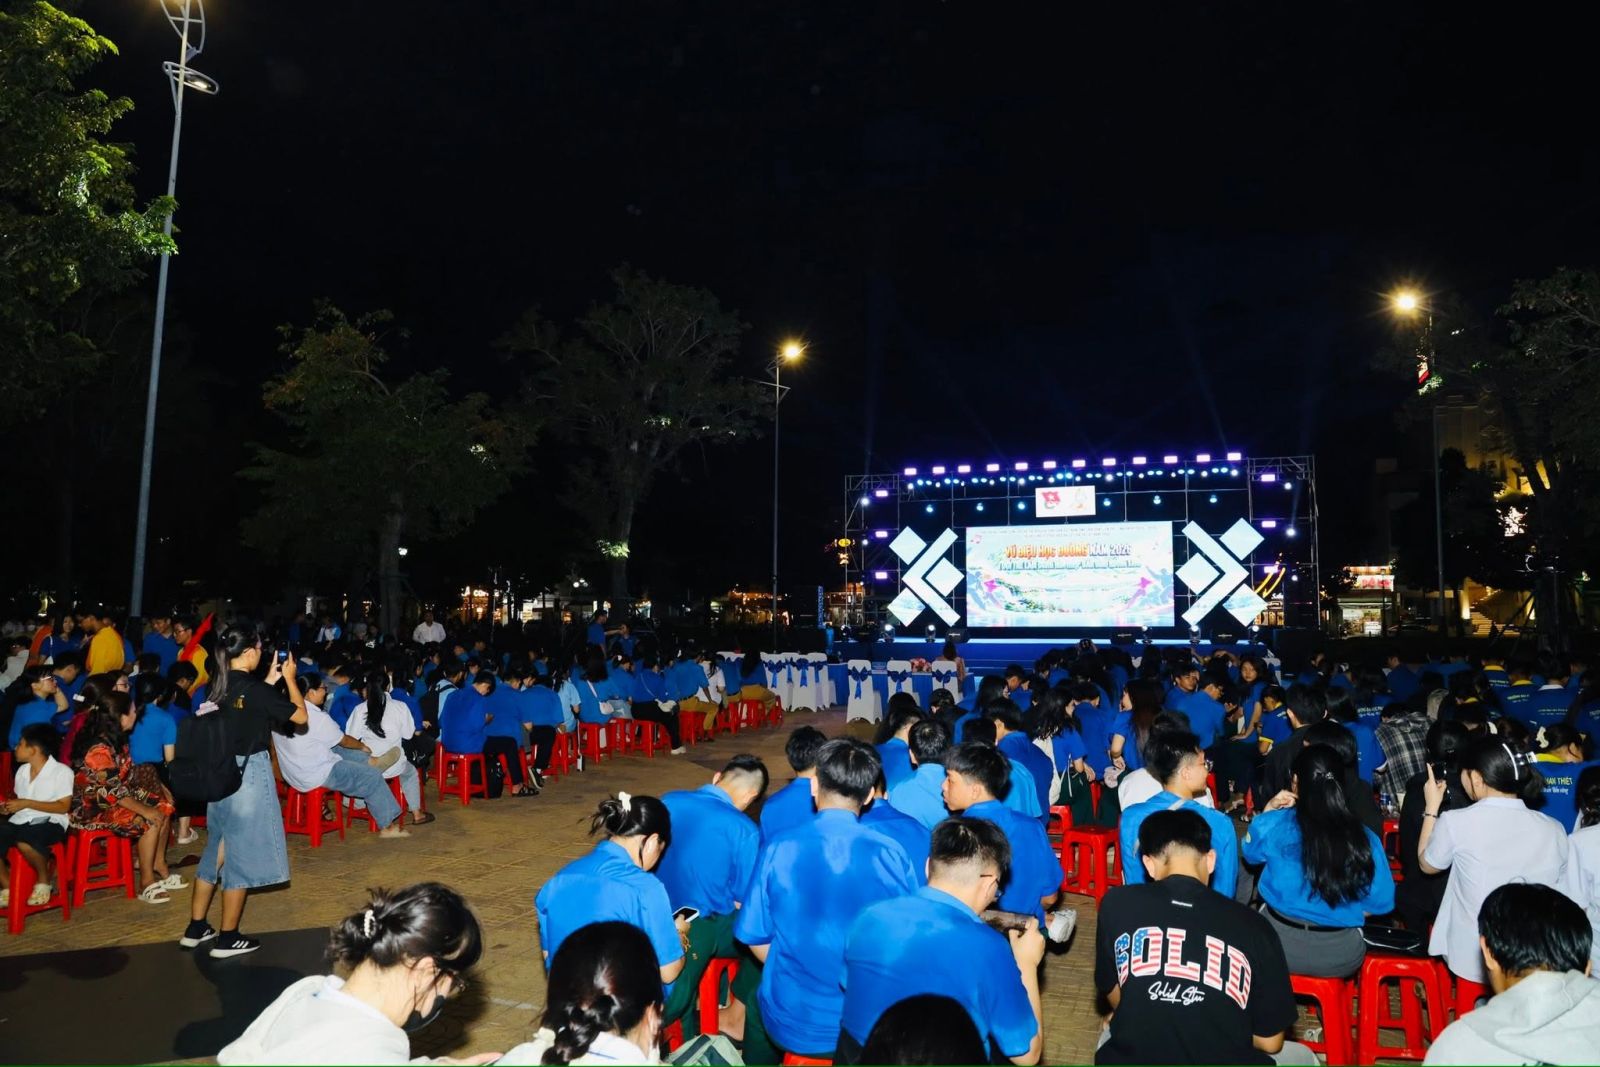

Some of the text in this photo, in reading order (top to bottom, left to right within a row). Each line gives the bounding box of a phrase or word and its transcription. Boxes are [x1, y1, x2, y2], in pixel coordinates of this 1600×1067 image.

[1018, 544, 1037, 559] ĐIỆU
[1038, 544, 1057, 560] HỌC
[1058, 541, 1089, 558] ĐƯỜNG
[1557, 775, 1573, 786] THIẾT
[1114, 926, 1252, 1010] SOLID
[1148, 981, 1181, 1003] Solid
